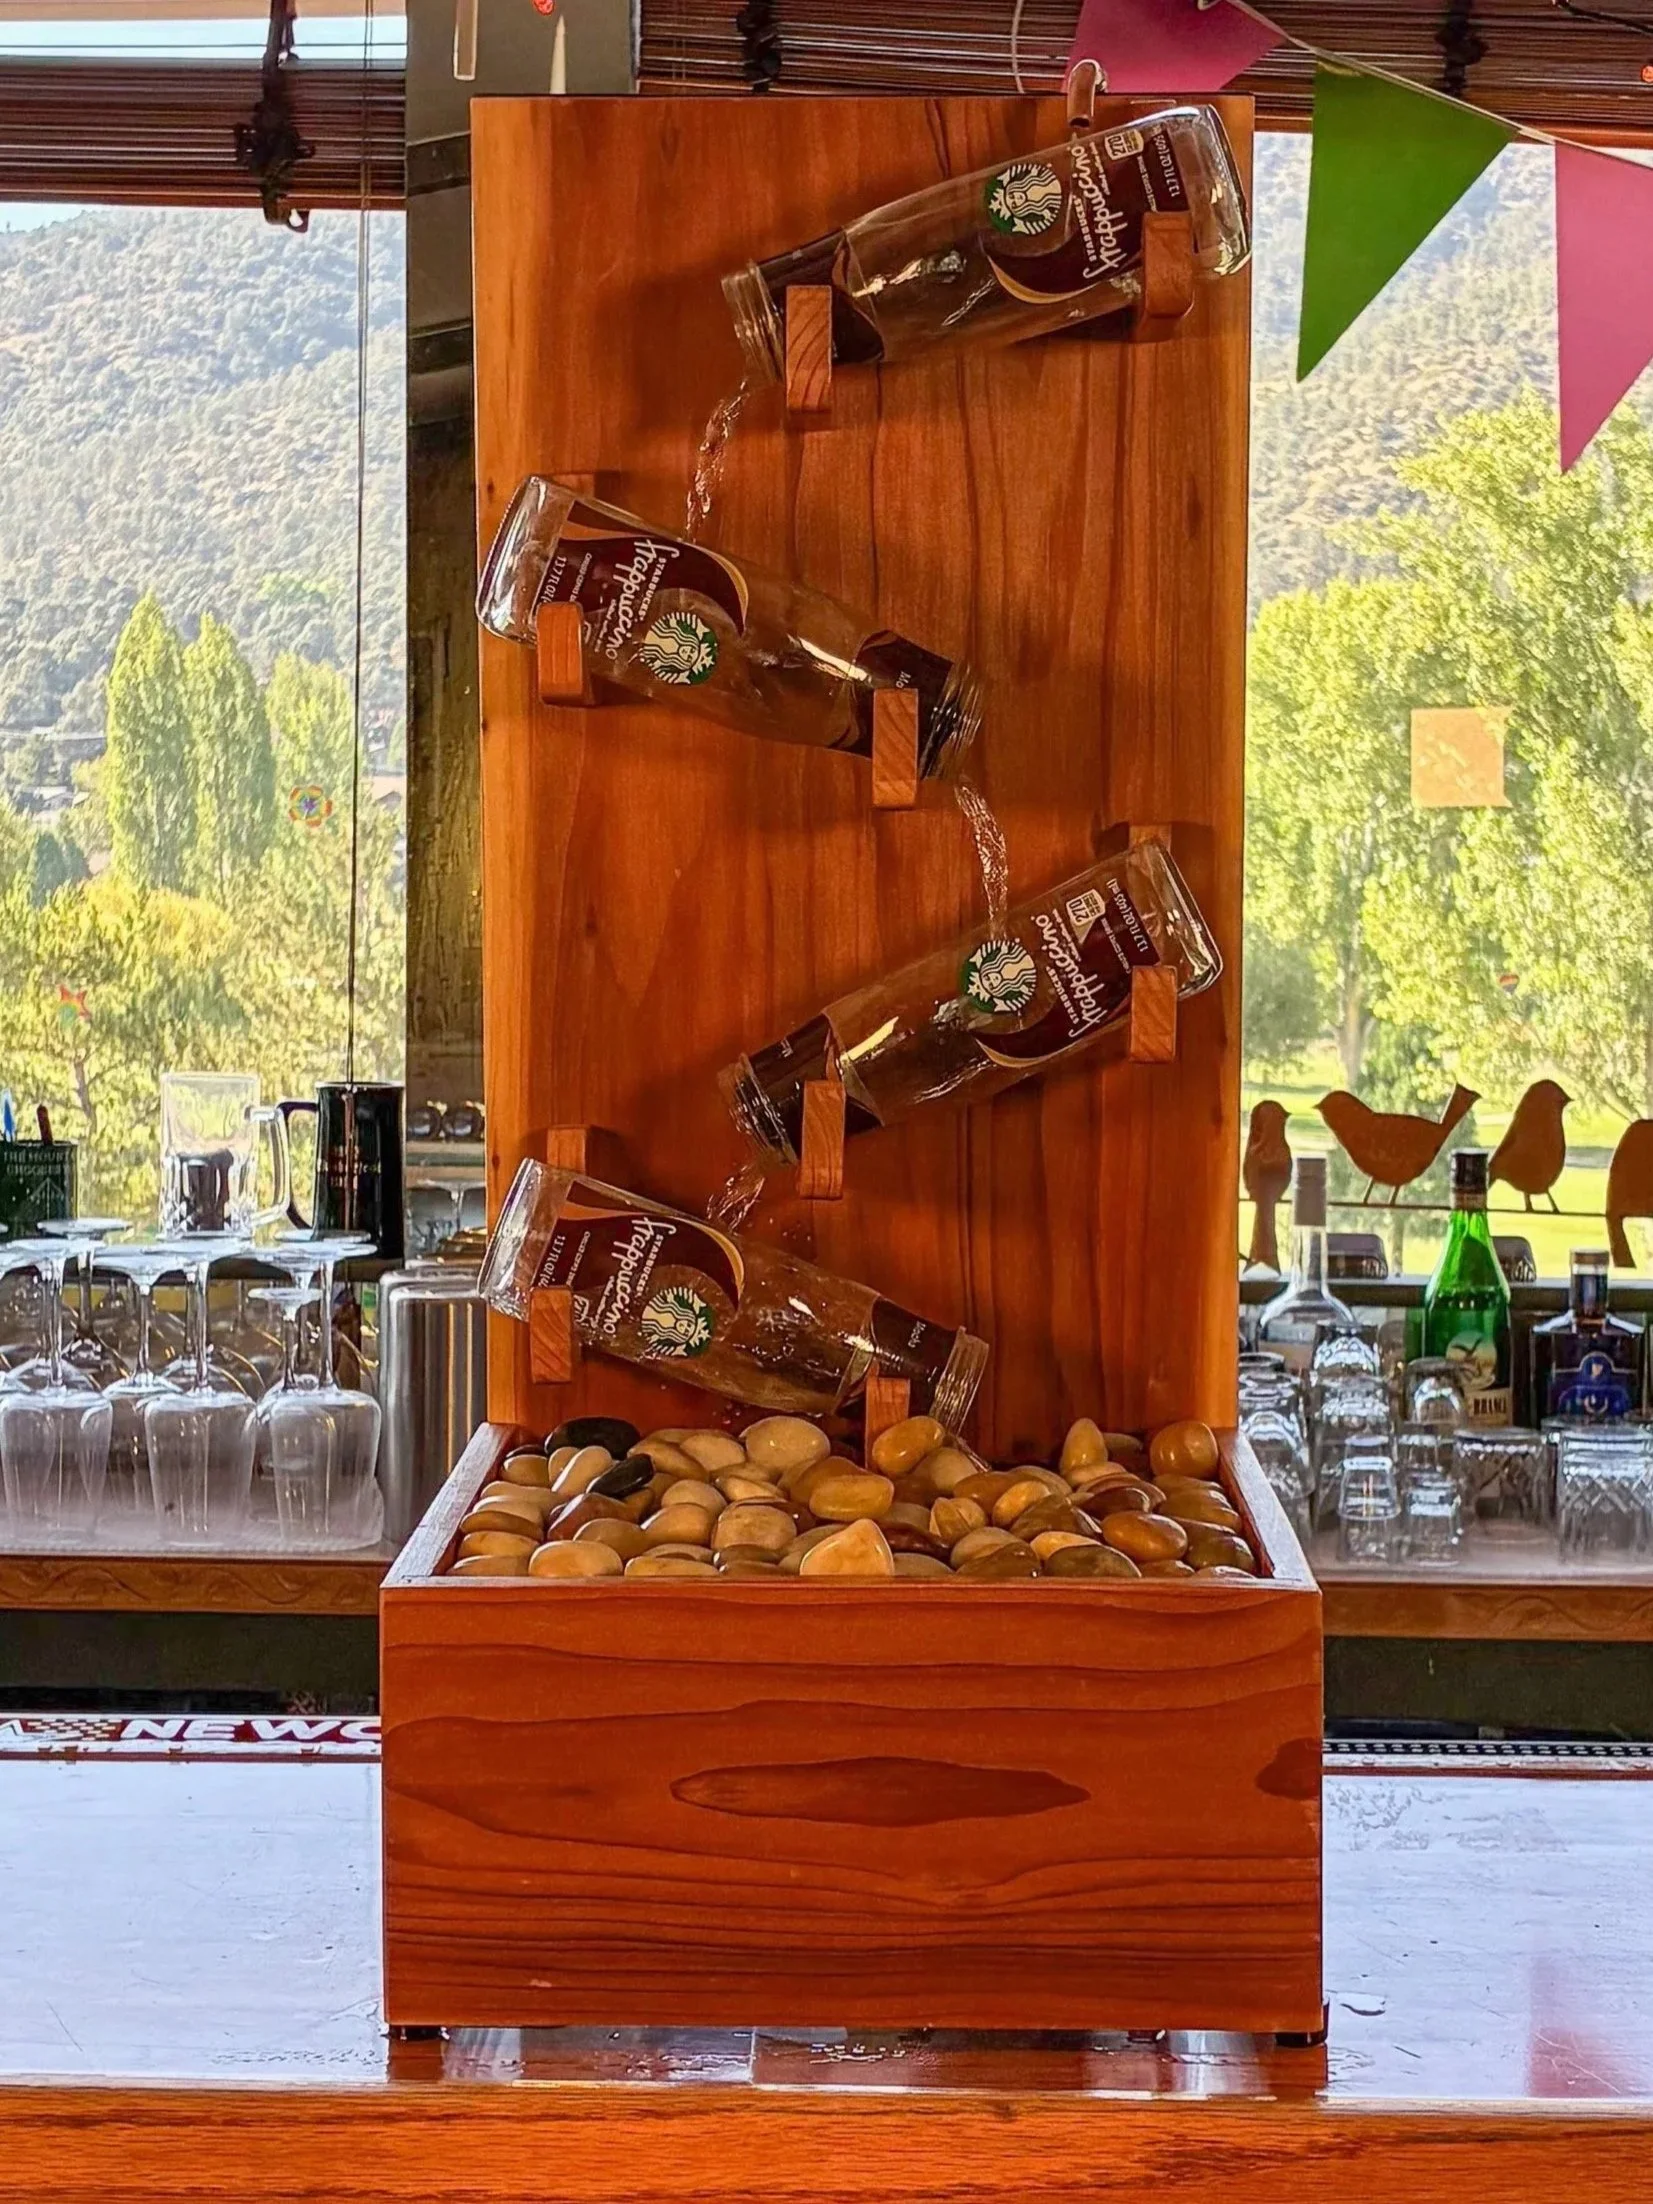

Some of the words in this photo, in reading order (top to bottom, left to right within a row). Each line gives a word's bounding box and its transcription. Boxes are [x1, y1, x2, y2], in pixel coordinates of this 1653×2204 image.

[1107, 135, 1125, 156] 270
[1073, 198, 1097, 262] STARBUCKS
[637, 558, 667, 614] STARBUCKS
[1068, 898, 1090, 923] 270
[1047, 968, 1081, 1025] STARBUCKS
[635, 1234, 663, 1291] STARBUCKS
